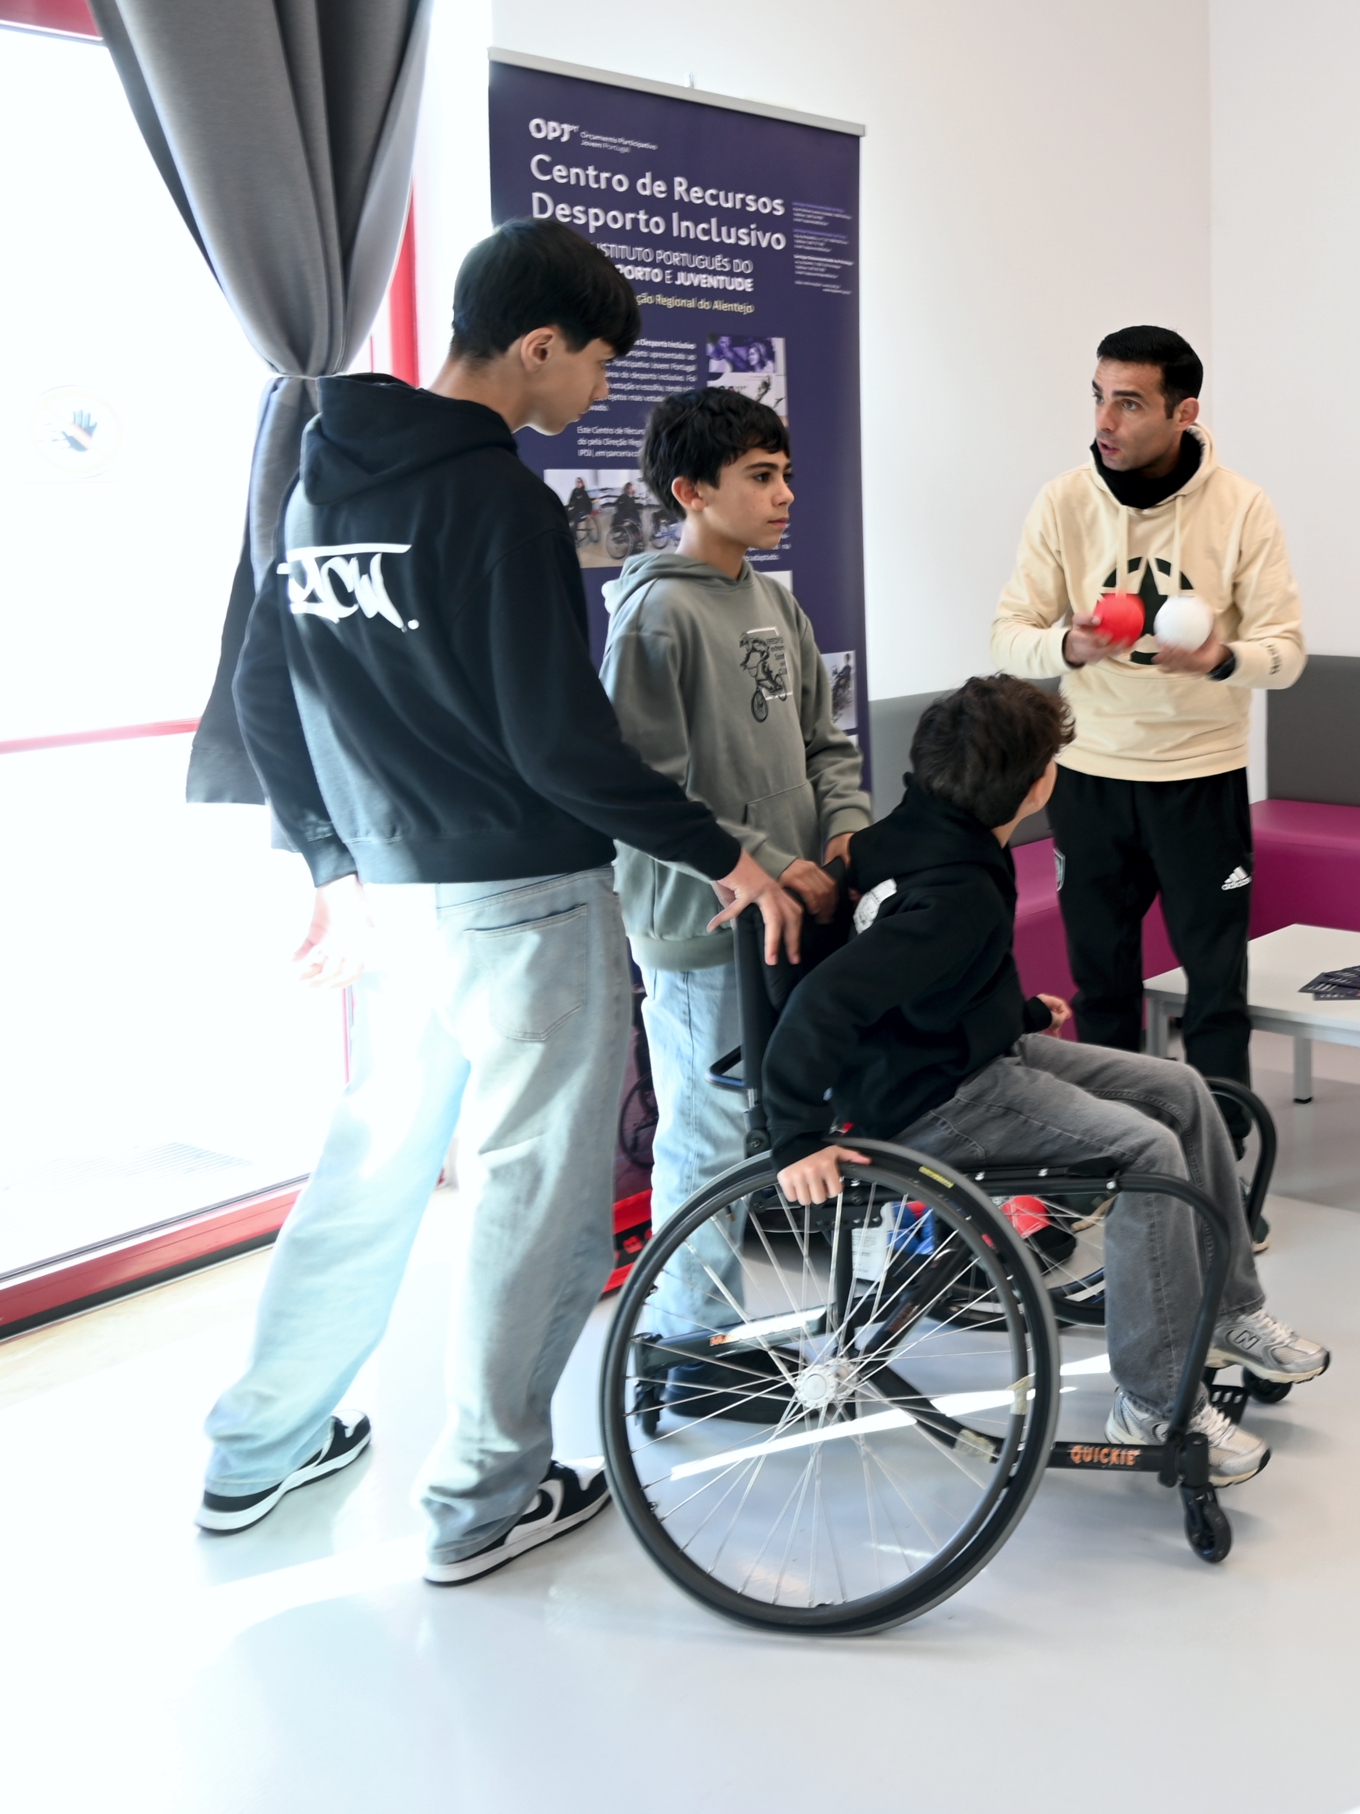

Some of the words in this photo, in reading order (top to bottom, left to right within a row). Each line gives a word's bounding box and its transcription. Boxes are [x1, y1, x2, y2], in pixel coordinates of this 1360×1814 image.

[530, 154, 630, 192] Centro
[636, 171, 668, 199] de
[673, 176, 786, 216] Recursos
[531, 191, 666, 236] Desporto
[672, 211, 787, 251] Inclusivo
[596, 242, 655, 262] STITUTO
[655, 248, 732, 272] PORTUGUÊS
[733, 258, 754, 274] DO
[664, 269, 674, 284] E
[674, 270, 755, 293] JUVENTUDE
[655, 294, 697, 309] Regional
[697, 298, 712, 310] do
[712, 299, 756, 316] Alentejo
[591, 426, 614, 436] Centro
[1070, 1445, 1138, 1466] QUICKIE
